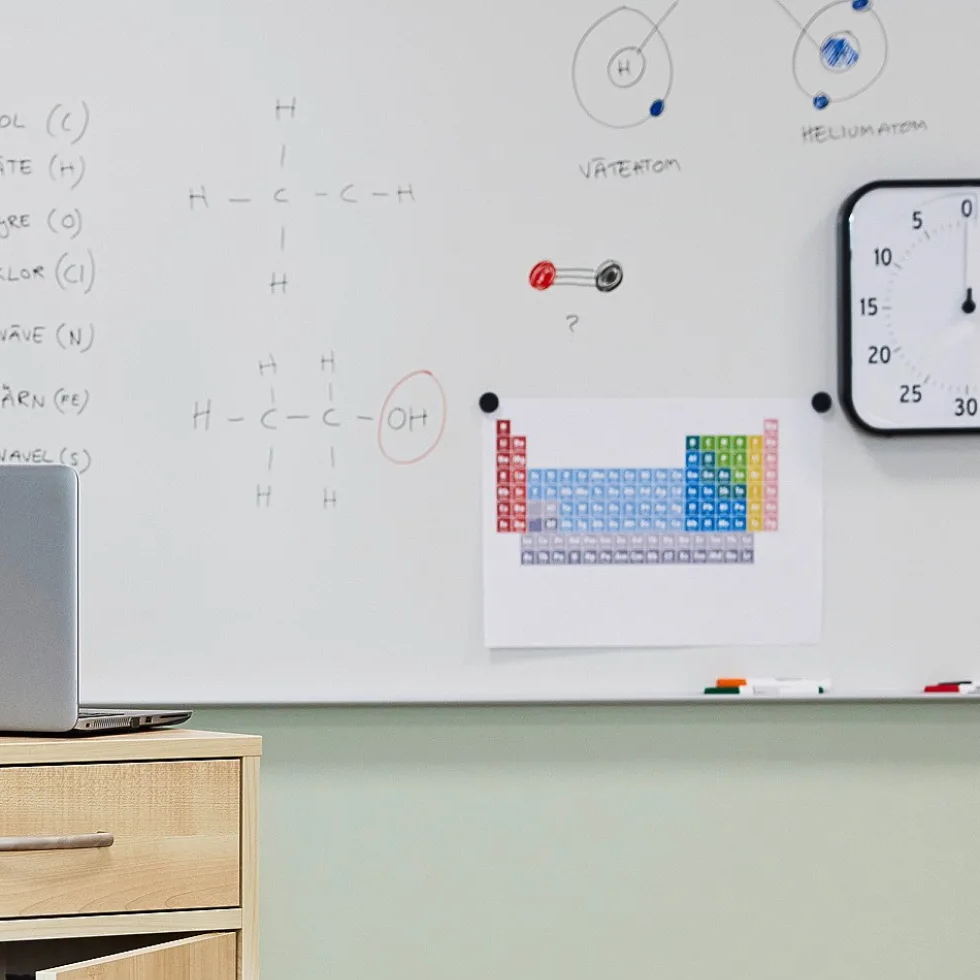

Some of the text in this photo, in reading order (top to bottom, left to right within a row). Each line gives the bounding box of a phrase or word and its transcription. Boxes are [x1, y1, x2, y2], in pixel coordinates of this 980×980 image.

[961, 198, 973, 217] 0
[912, 211, 923, 229] 5
[874, 248, 893, 267] 10
[860, 297, 878, 316] 15
[868, 345, 891, 364] 20
[899, 384, 922, 403] 25
[954, 398, 978, 417] 30
[388, 406, 427, 432] OH
